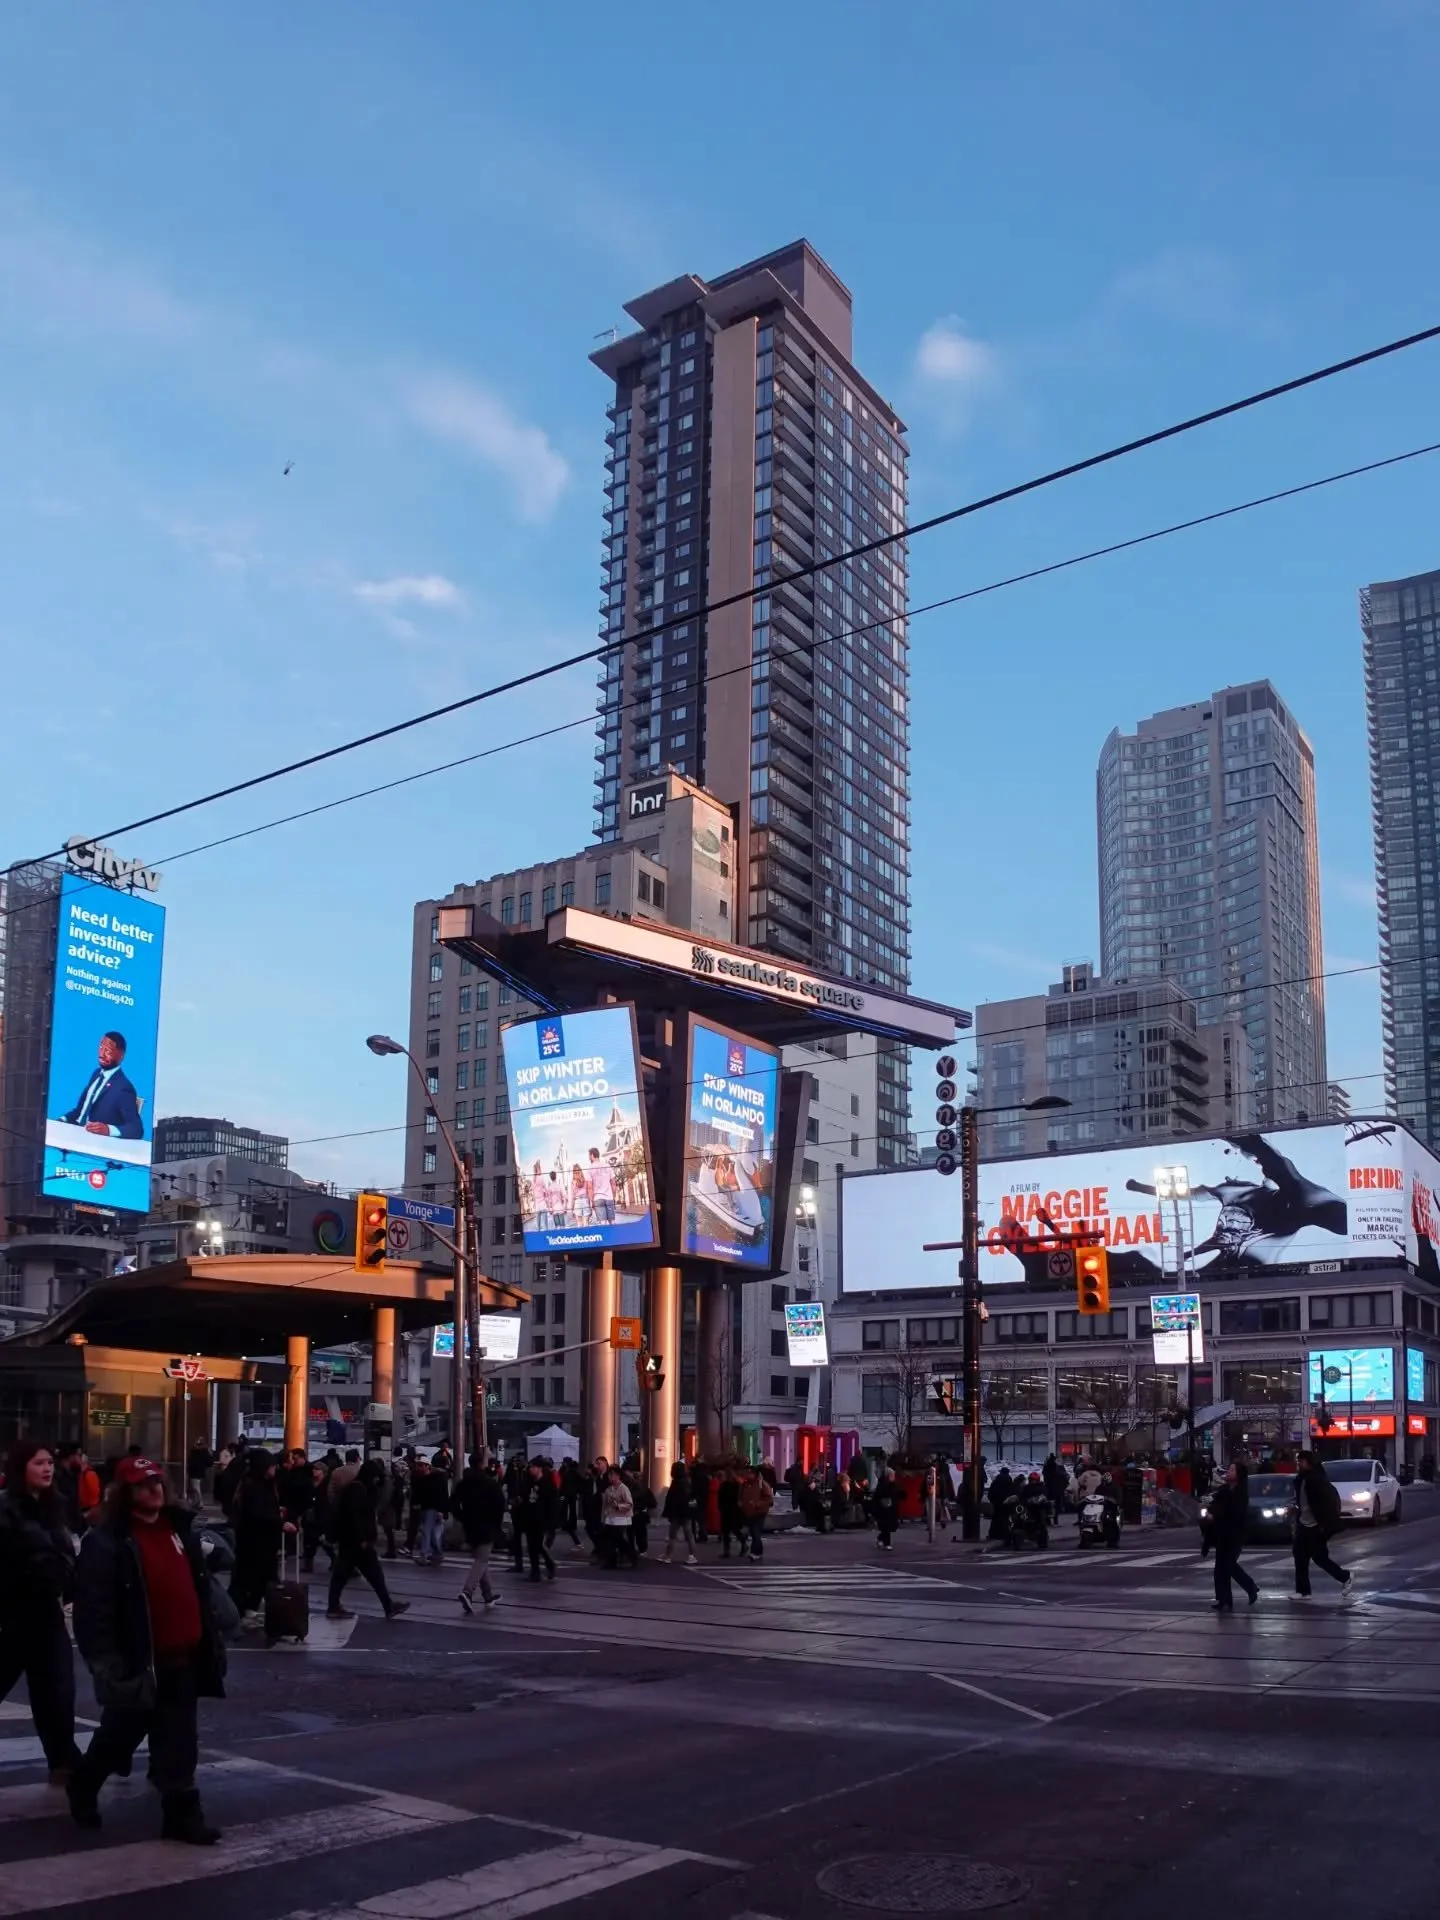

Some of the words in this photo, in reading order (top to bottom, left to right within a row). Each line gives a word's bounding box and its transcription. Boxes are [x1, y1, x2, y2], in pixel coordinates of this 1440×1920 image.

[631, 792, 664, 815] hnr
[67, 835, 163, 892] Citytv
[70, 904, 108, 929] Need
[112, 916, 154, 943] better
[69, 922, 134, 959] investing
[68, 943, 121, 970] advice?
[65, 980, 134, 1006] @crypto.king420
[66, 966, 100, 985] Nothing
[101, 975, 131, 992] against
[718, 957, 797, 992] sankofa
[800, 980, 865, 1010] square
[516, 1066, 540, 1085] SKIP
[542, 1056, 606, 1081] WINTER
[518, 1090, 529, 1106] IN
[530, 1078, 609, 1105] ORLANDO
[703, 1072, 726, 1093] SKIP
[728, 1081, 765, 1108] WINTER
[702, 1091, 713, 1109] IN
[715, 1096, 765, 1125] ORLANDO
[1016, 1183, 1031, 1193] FILM
[404, 1200, 433, 1221] Yonge
[1001, 1187, 1109, 1222] MAGGIE
[1367, 1223, 1394, 1232] MARCH
[1313, 1263, 1337, 1272] astral
